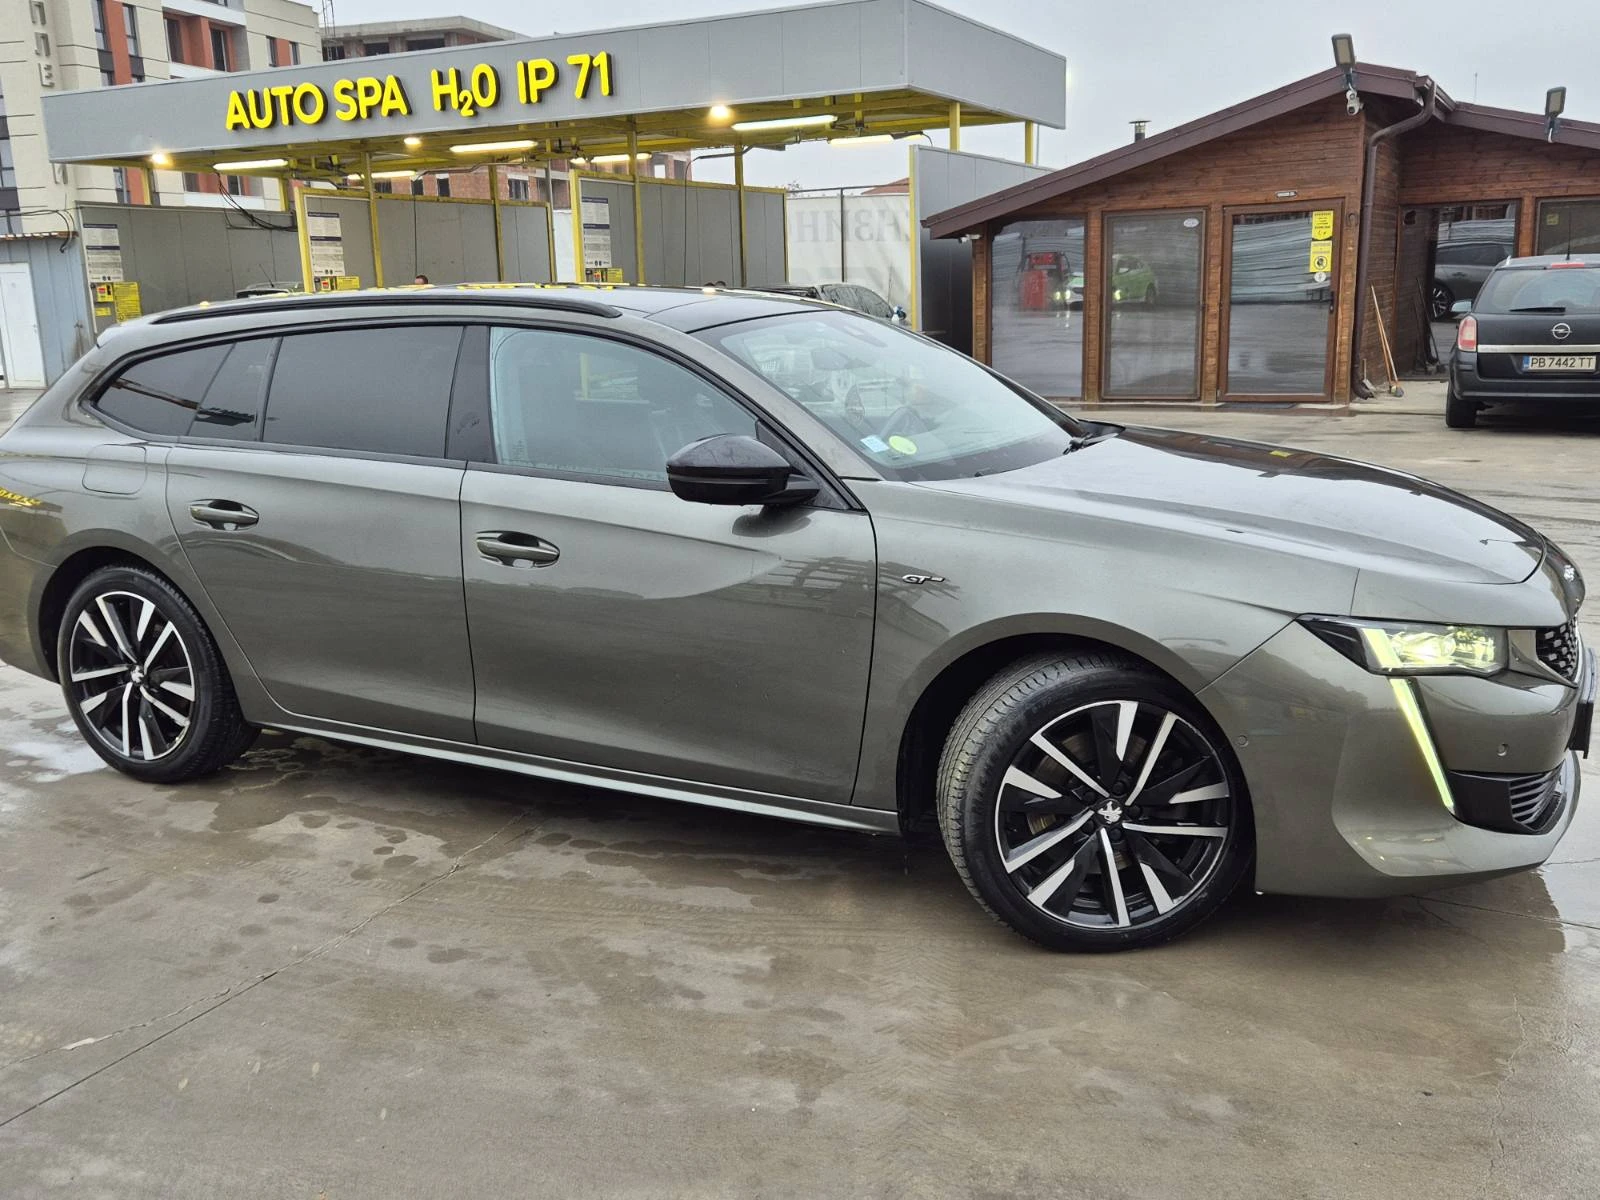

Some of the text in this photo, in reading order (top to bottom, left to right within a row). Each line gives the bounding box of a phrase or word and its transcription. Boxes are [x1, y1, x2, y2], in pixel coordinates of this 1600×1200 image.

[225, 82, 325, 131] AUTO
[333, 74, 409, 122] SPA
[516, 58, 556, 104] IP
[566, 51, 610, 99] 71
[1531, 357, 1593, 368] PB 7442 TT
